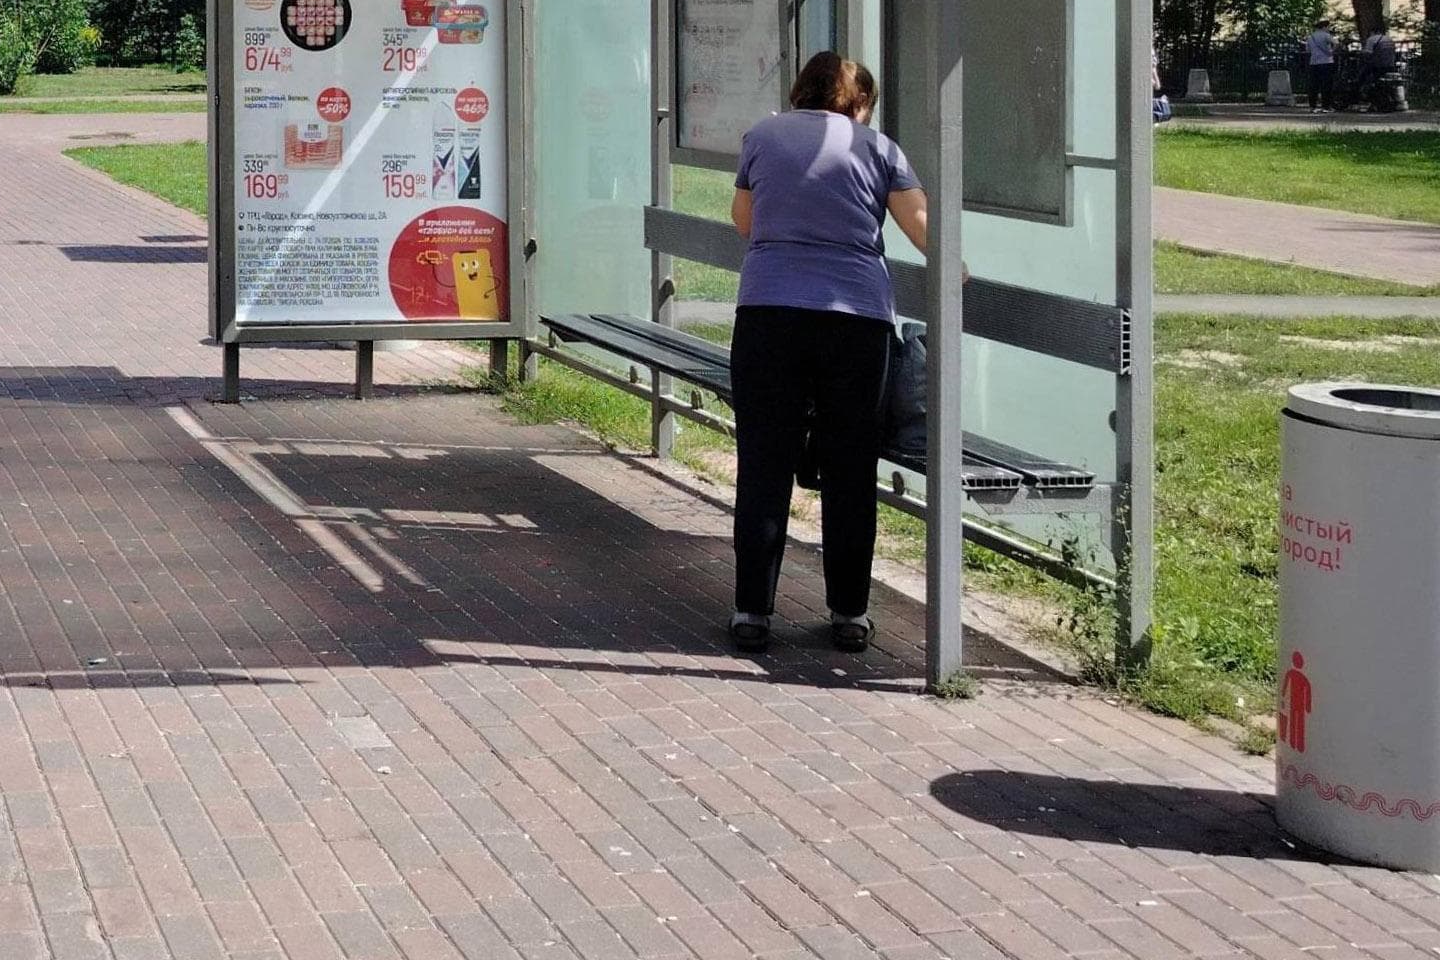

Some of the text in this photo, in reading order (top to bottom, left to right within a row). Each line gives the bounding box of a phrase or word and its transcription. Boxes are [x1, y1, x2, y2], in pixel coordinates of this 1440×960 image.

[245, 33, 265, 46] 899
[383, 33, 403, 46] 345
[245, 46, 281, 71] 674
[383, 47, 416, 71] 219
[243, 160, 263, 172] 339
[382, 160, 401, 172] 296
[244, 174, 277, 198] 169
[382, 174, 416, 198] 159
[416, 175, 426, 185] 99
[1280, 533, 1340, 572] ород!
